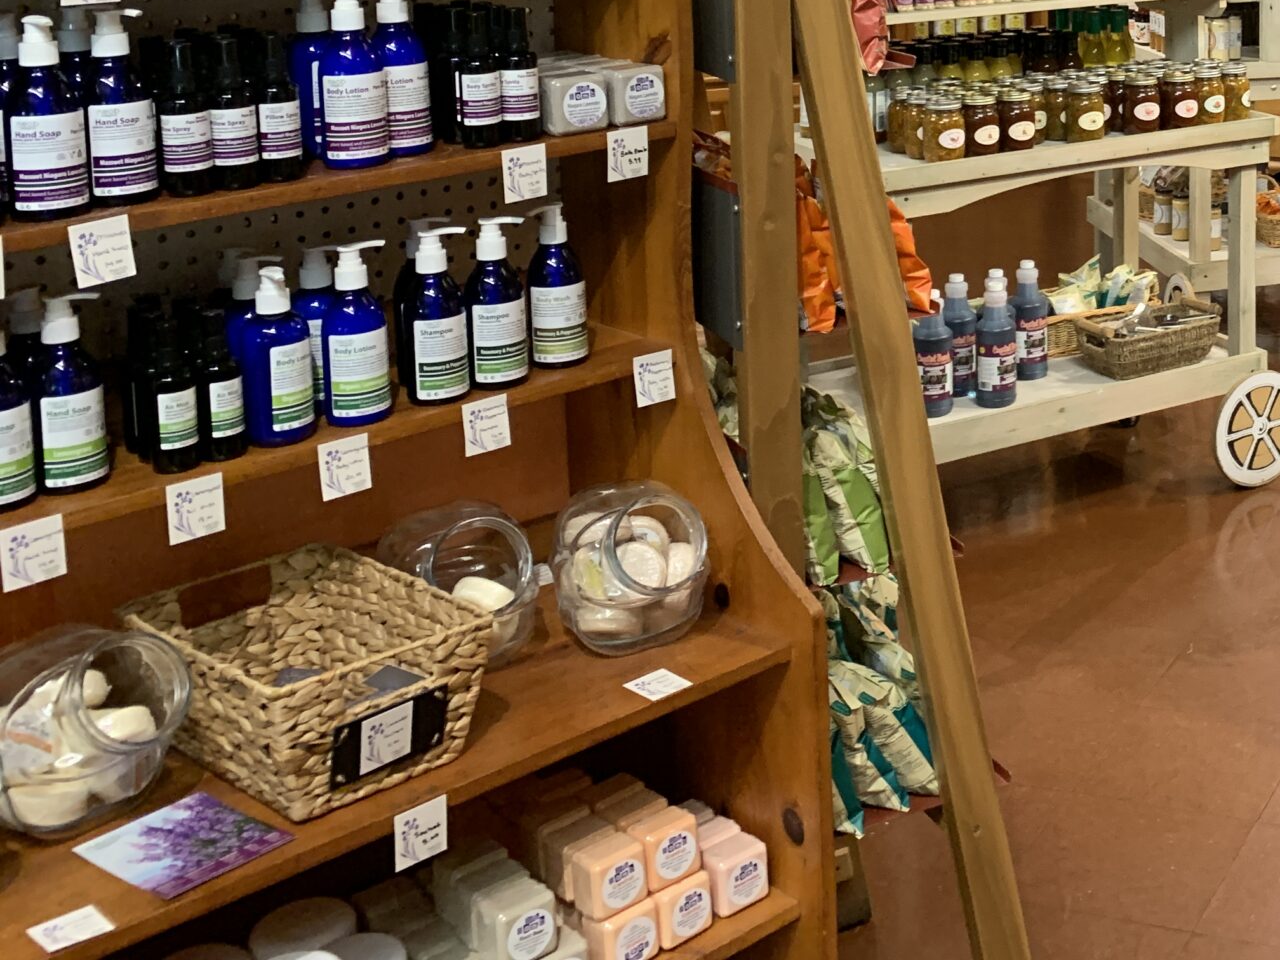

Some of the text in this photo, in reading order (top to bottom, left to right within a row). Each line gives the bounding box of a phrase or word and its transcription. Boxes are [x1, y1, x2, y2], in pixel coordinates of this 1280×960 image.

[390, 77, 414, 85] Lotion
[326, 86, 370, 96] Body Lotion
[95, 116, 141, 126] Hand Soap
[14, 129, 62, 139] Hand Soap
[478, 312, 510, 321] Shampoo
[420, 327, 454, 337] Shampoo
[354, 344, 377, 353] Lotion
